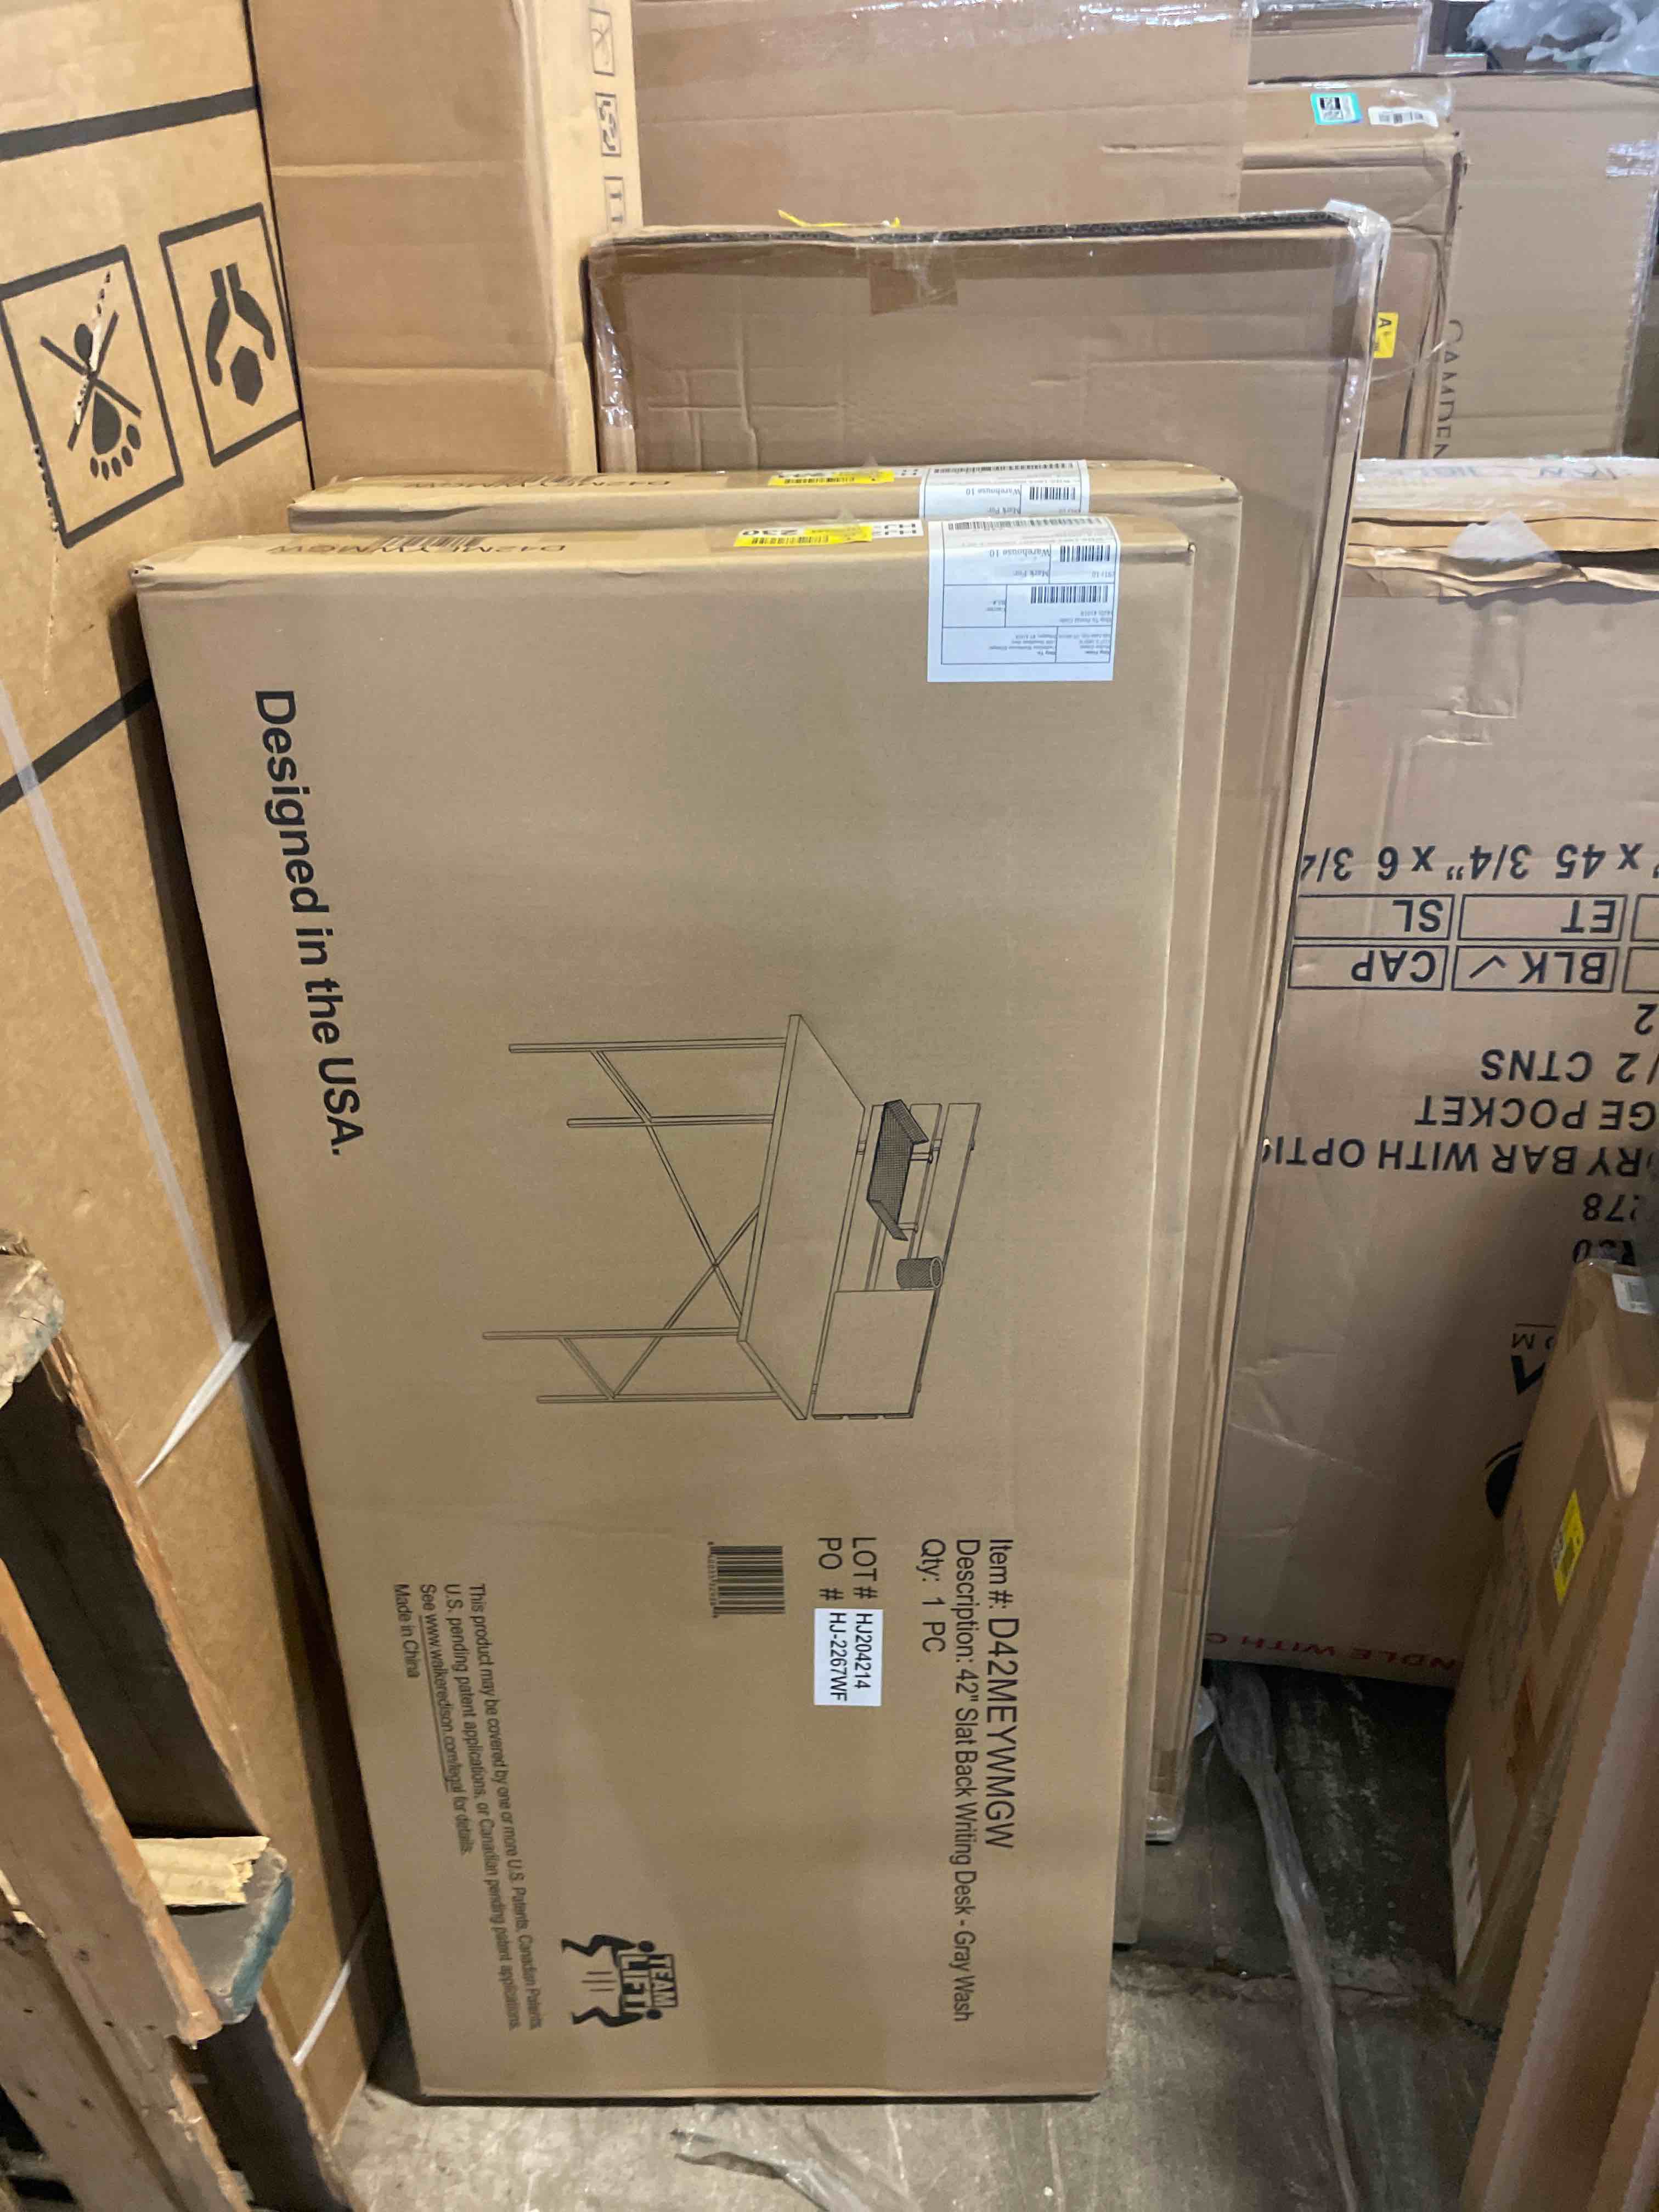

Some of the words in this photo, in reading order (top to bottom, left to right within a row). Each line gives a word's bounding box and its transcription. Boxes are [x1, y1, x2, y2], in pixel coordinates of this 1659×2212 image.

[966, 487, 975, 496] 10
[977, 486, 1022, 496] Warehouse
[989, 549, 1000, 557] 10
[1002, 548, 1051, 557] Warehouse
[1027, 568, 1049, 577] Mark
[255, 690, 329, 913] Designed
[1377, 845, 1399, 882] 6
[1411, 845, 1436, 872] x
[1556, 843, 1606, 879] 45
[1392, 899, 1444, 933] SL
[1560, 899, 1616, 934] ET
[295, 928, 334, 966] in
[1351, 950, 1436, 983] CAP
[1519, 950, 1607, 984] BLK
[304, 977, 343, 1045] the
[1481, 1049, 1594, 1082] CTNS
[318, 1057, 364, 1156] USA.
[1414, 1095, 1588, 1128] POCKET
[1378, 1138, 1479, 1172] WITH
[1491, 1143, 1578, 1175] BAR
[817, 1537, 843, 1570] PO
[851, 1537, 878, 1582] LOT
[916, 1538, 946, 1582] Qty:
[989, 1539, 1014, 1585] Item
[393, 1584, 413, 1622] Made
[443, 1583, 464, 1613] U.S.
[470, 1583, 487, 1613] This
[819, 1588, 844, 1601] #
[922, 1596, 946, 1606] 1
[950, 1539, 981, 1663] Description:
[400, 1624, 413, 1638] in
[446, 1617, 471, 1673] pending
[470, 1616, 494, 1666] product
[922, 1621, 946, 1653] PC
[1241, 1635, 1336, 1656] WITH
[402, 1639, 420, 1679] China
[829, 1612, 848, 1701] HJ-2267WF
[854, 1613, 873, 1689] HJ204214
[419, 1583, 437, 1611] See
[453, 1795, 467, 1813] for
[453, 1676, 477, 1718] patent
[479, 1668, 495, 1696] may
[955, 1668, 979, 1702] 42"
[484, 1699, 501, 1716] be
[487, 1718, 507, 1767] covered
[955, 1707, 979, 1746] Slat
[985, 1618, 1020, 1848] D42MEYWMGW
[492, 1769, 510, 1784] by
[955, 1751, 979, 1798] Back
[476, 1802, 490, 1816] or
[497, 1787, 511, 1810] one
[501, 1813, 513, 1826] or
[949, 1801, 978, 1865] Writing
[478, 1818, 500, 1876] Canadian
[504, 1825, 518, 1857] more
[483, 1878, 506, 1923] pending
[954, 1870, 977, 1915] Desk
[490, 1927, 512, 1962] patent
[518, 1934, 539, 1986] Canadian
[948, 1930, 977, 1972] Gray
[953, 1976, 975, 2022] Wash
